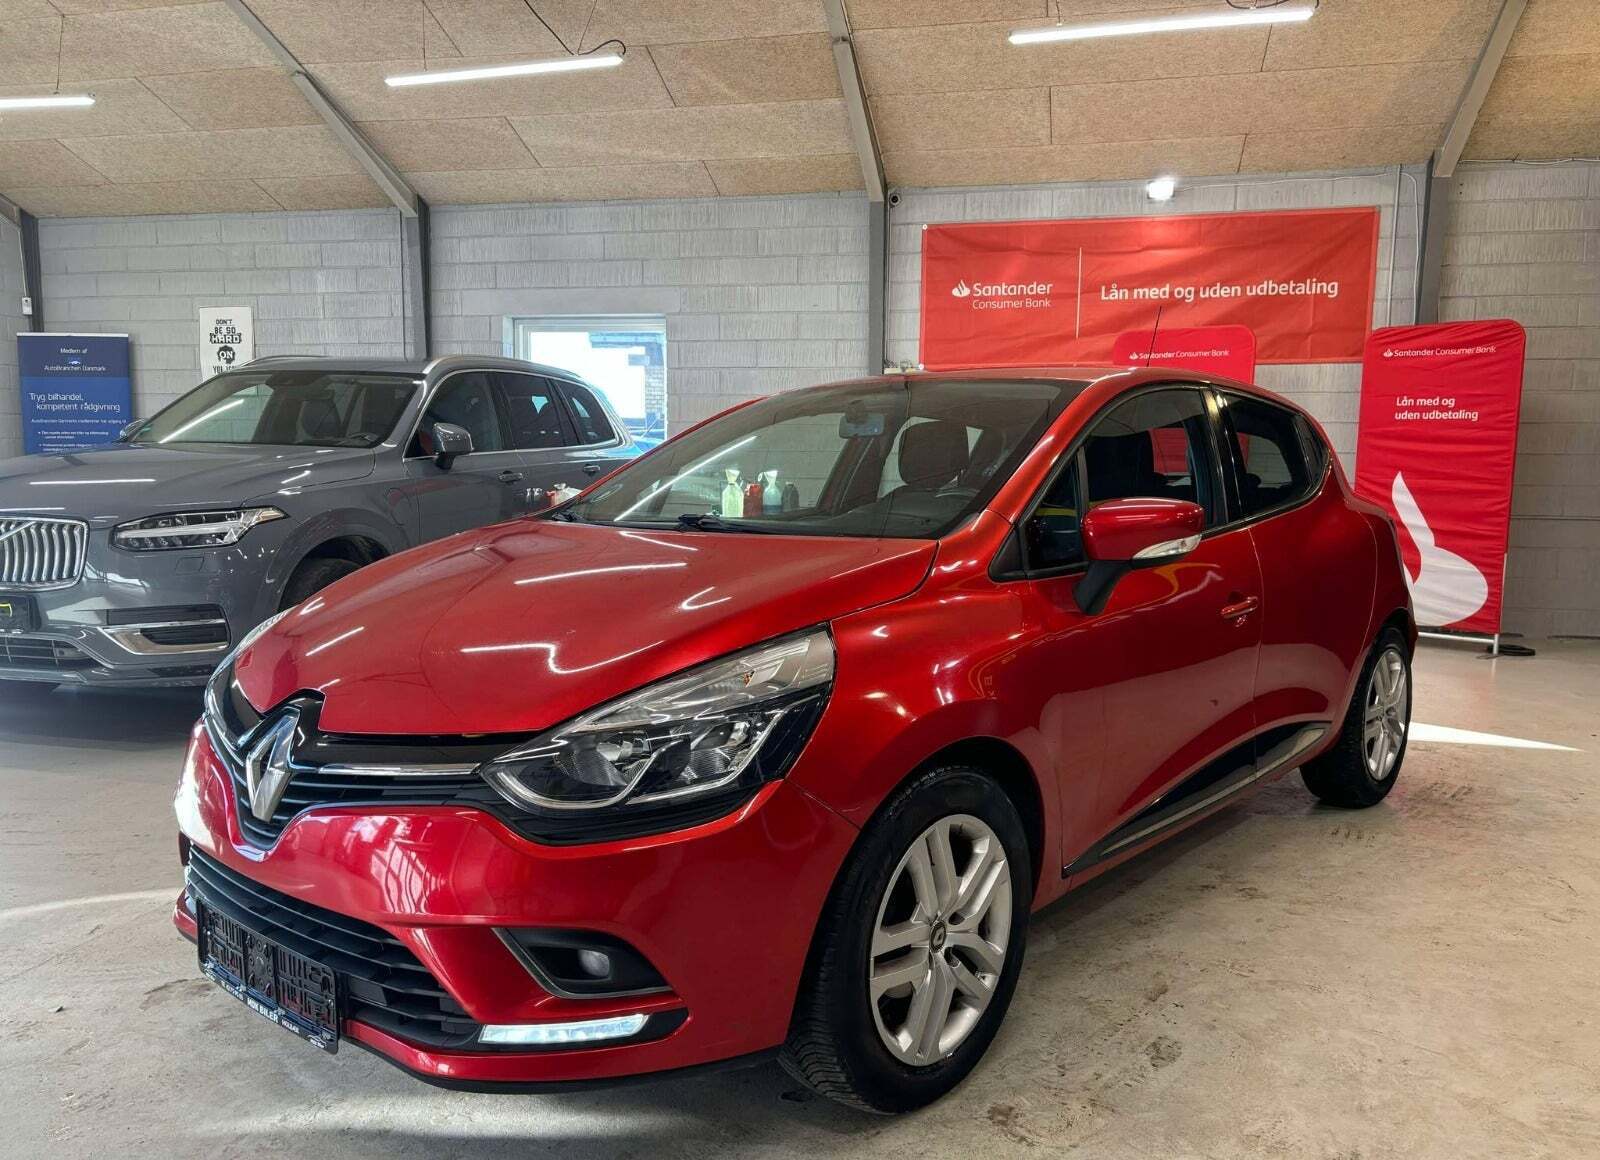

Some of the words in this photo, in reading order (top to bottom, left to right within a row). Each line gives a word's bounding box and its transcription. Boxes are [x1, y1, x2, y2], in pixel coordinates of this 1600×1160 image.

[973, 282, 1053, 297] Santander
[1101, 283, 1129, 301] Lån
[1133, 284, 1170, 299] med
[1174, 286, 1195, 302] og
[1200, 282, 1241, 298] uden
[1246, 278, 1339, 298] udbetaling
[972, 299, 1024, 310] Consumer
[1025, 298, 1051, 308] Bank
[214, 327, 223, 335] BE
[225, 327, 236, 335] SO
[210, 334, 240, 344] HARD
[219, 350, 233, 360] ON
[1138, 351, 1176, 360] Santander
[1176, 350, 1211, 358] Consumer
[1212, 349, 1230, 357] Bank
[1393, 348, 1434, 358] Santander
[1435, 347, 1475, 356] Consumer
[1476, 345, 1497, 354] Bank
[29, 393, 46, 403] Tryg
[1396, 395, 1415, 407] Lån
[1416, 396, 1439, 407] med
[1441, 397, 1456, 408] og
[36, 403, 78, 412] kompetent
[80, 402, 121, 413] rådgivning
[1394, 410, 1420, 420] uden
[1422, 408, 1479, 422] udbetaling
